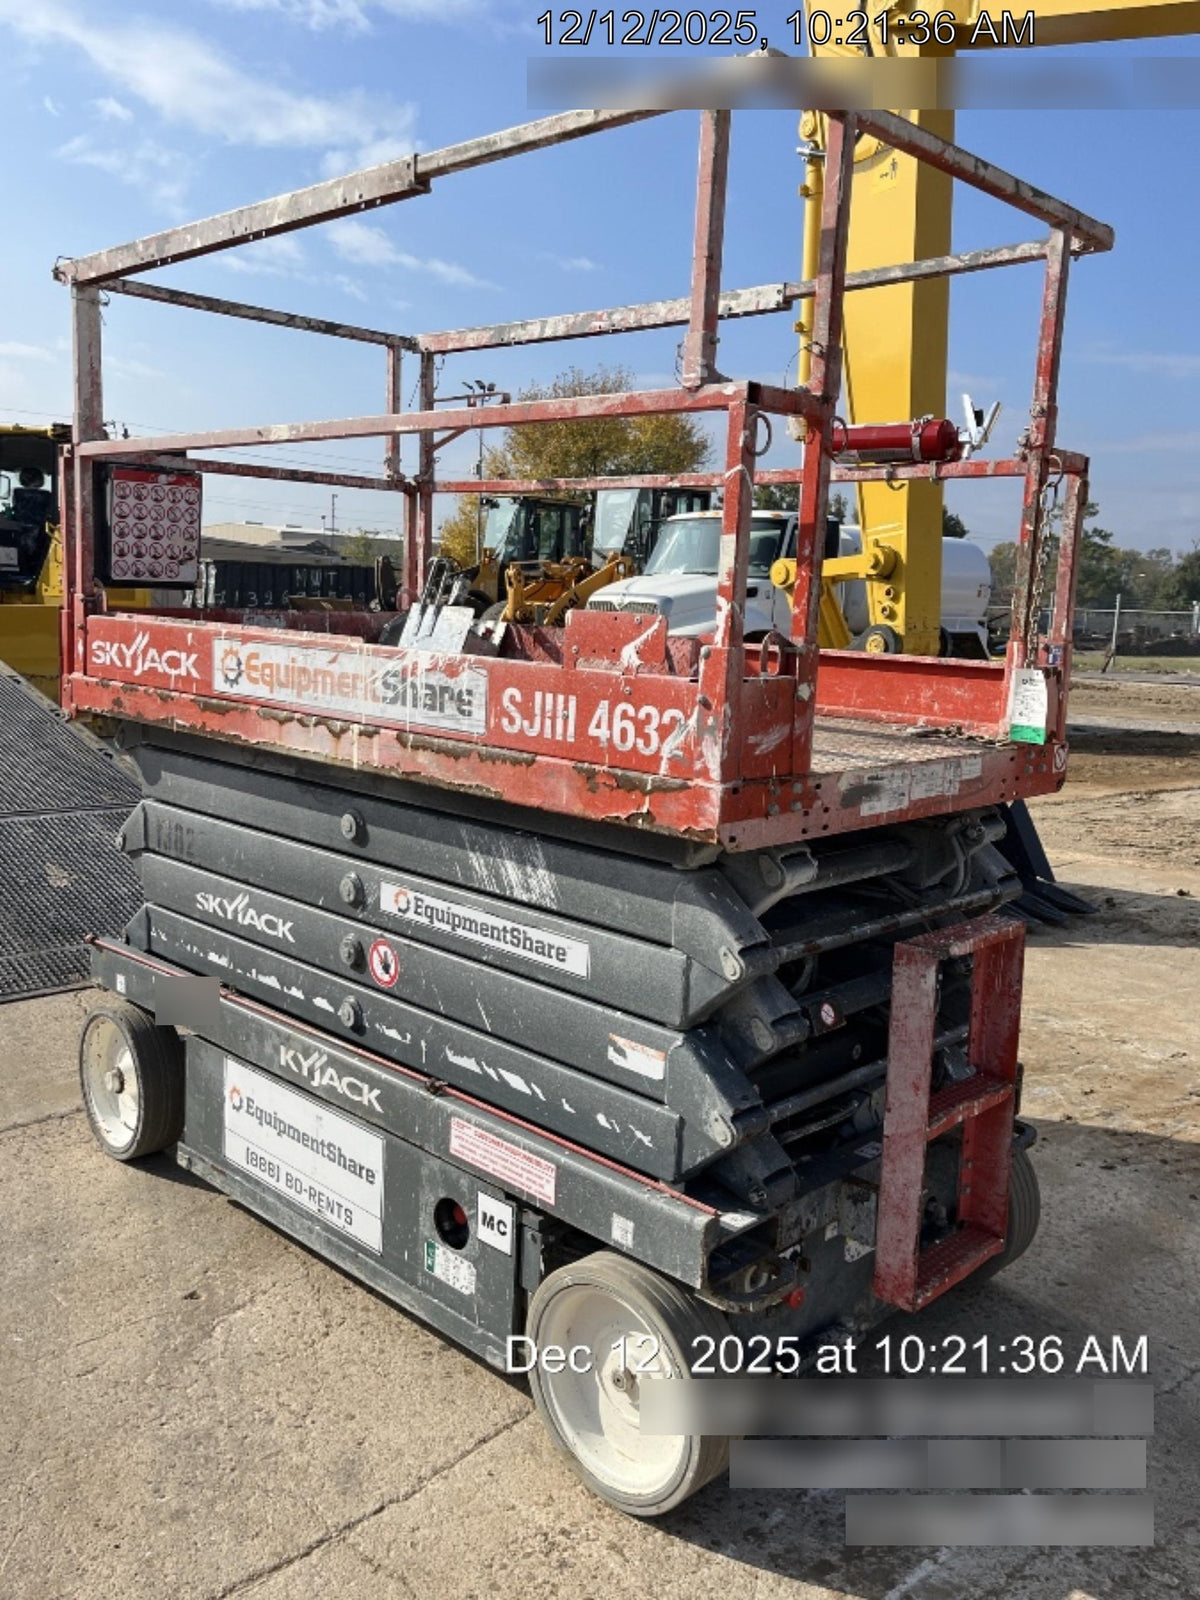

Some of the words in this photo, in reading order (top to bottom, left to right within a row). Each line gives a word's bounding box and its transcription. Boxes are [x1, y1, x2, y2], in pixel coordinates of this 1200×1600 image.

[91, 631, 200, 678] SKYJACK
[244, 651, 474, 718] EquipmentShare
[588, 700, 686, 758] 4632
[196, 892, 295, 943] SKYJACK
[413, 895, 568, 964] EquipmentShare
[245, 1096, 376, 1186] EquipmentShare
[481, 1211, 508, 1237] MC
